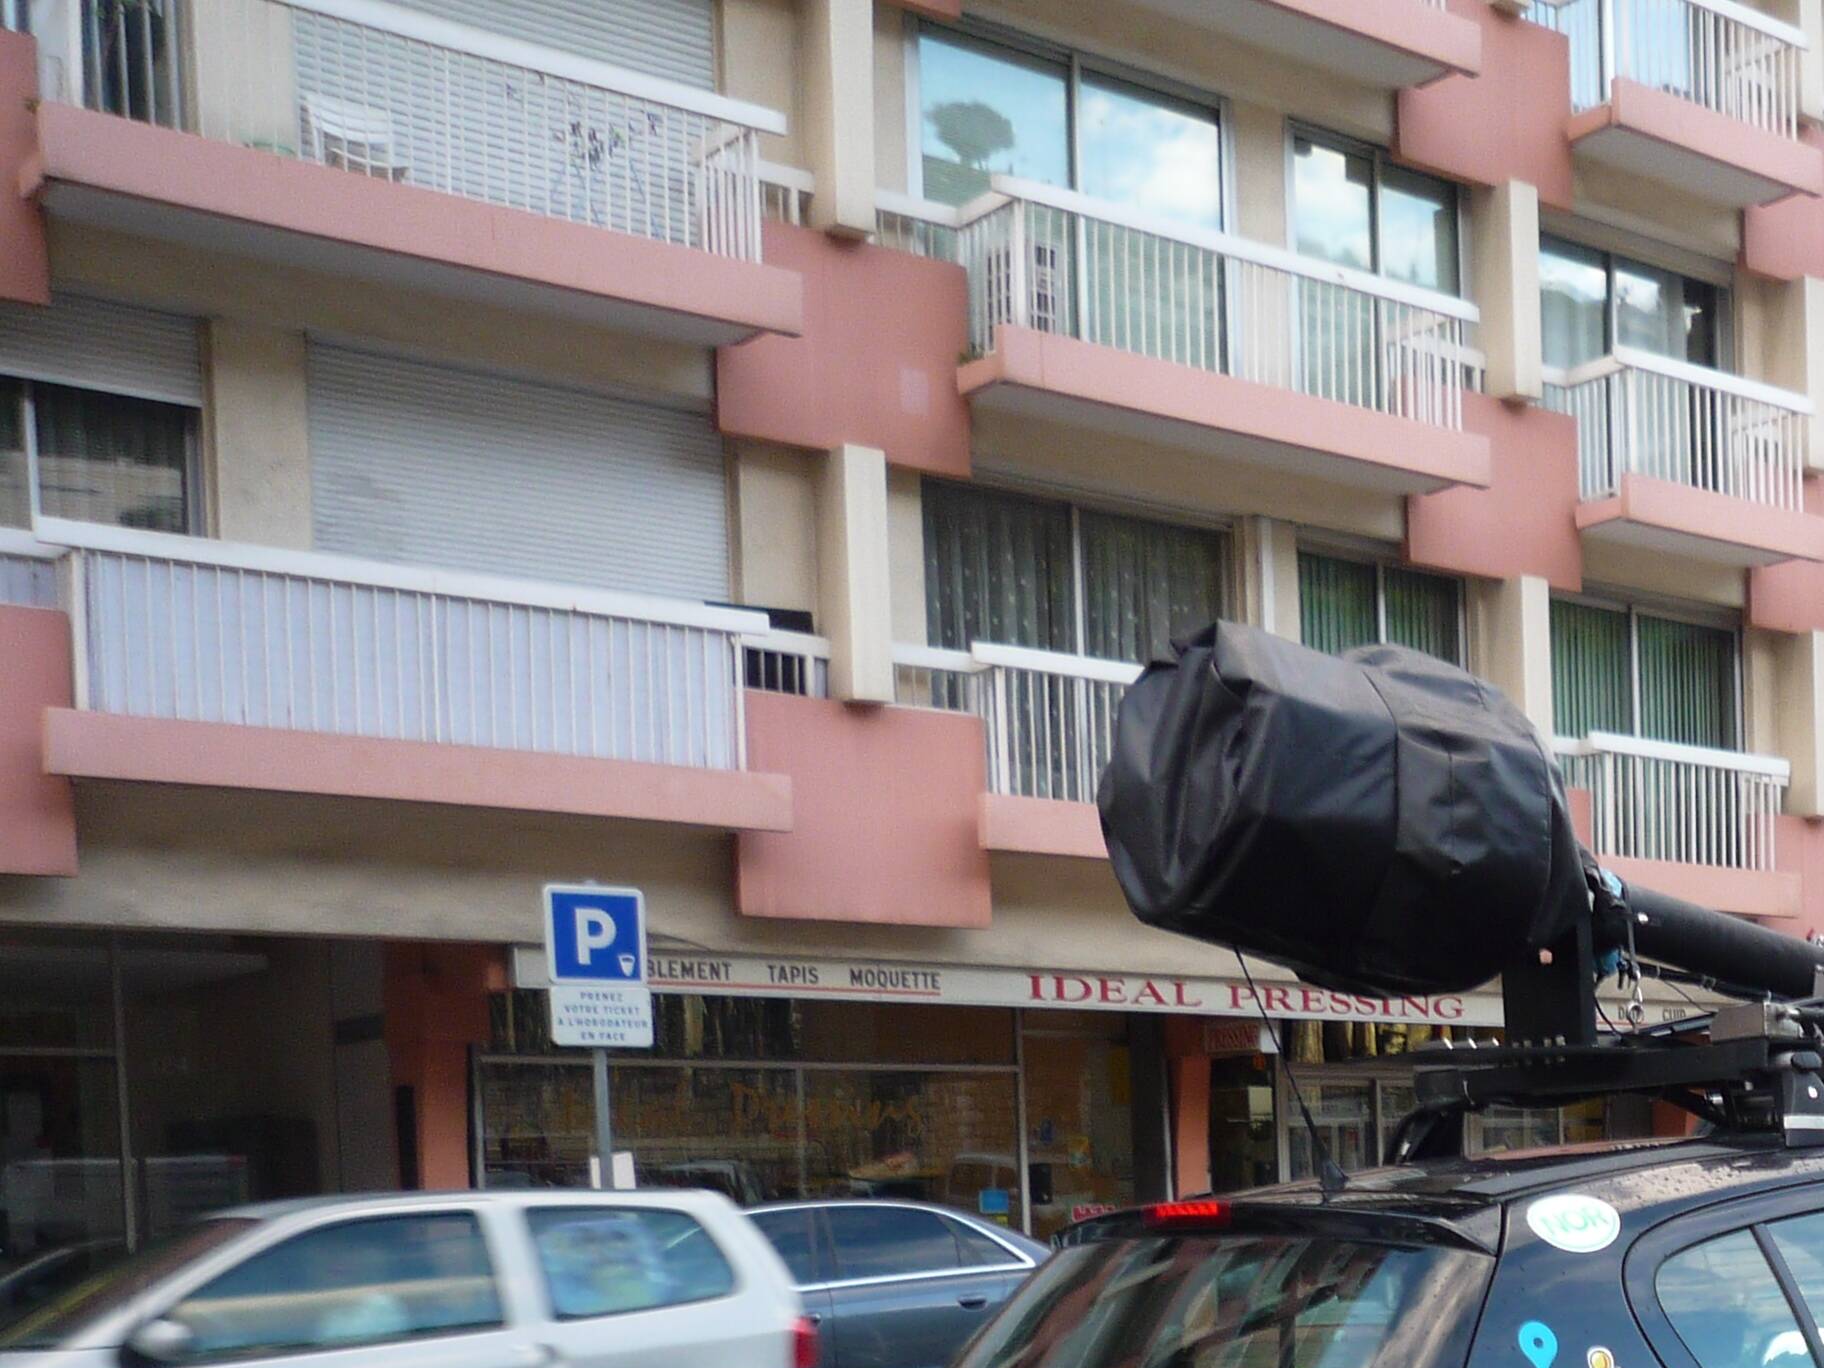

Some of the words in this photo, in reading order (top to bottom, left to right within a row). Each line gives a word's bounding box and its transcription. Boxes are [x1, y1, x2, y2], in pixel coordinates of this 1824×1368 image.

[574, 907, 617, 966] P
[767, 964, 820, 985] TAPIS
[850, 967, 941, 991] MOQUETTE
[1028, 973, 1204, 1008] IDEAL
[1227, 983, 1465, 1020] PRESSING
[1539, 1204, 1610, 1236] NOR
